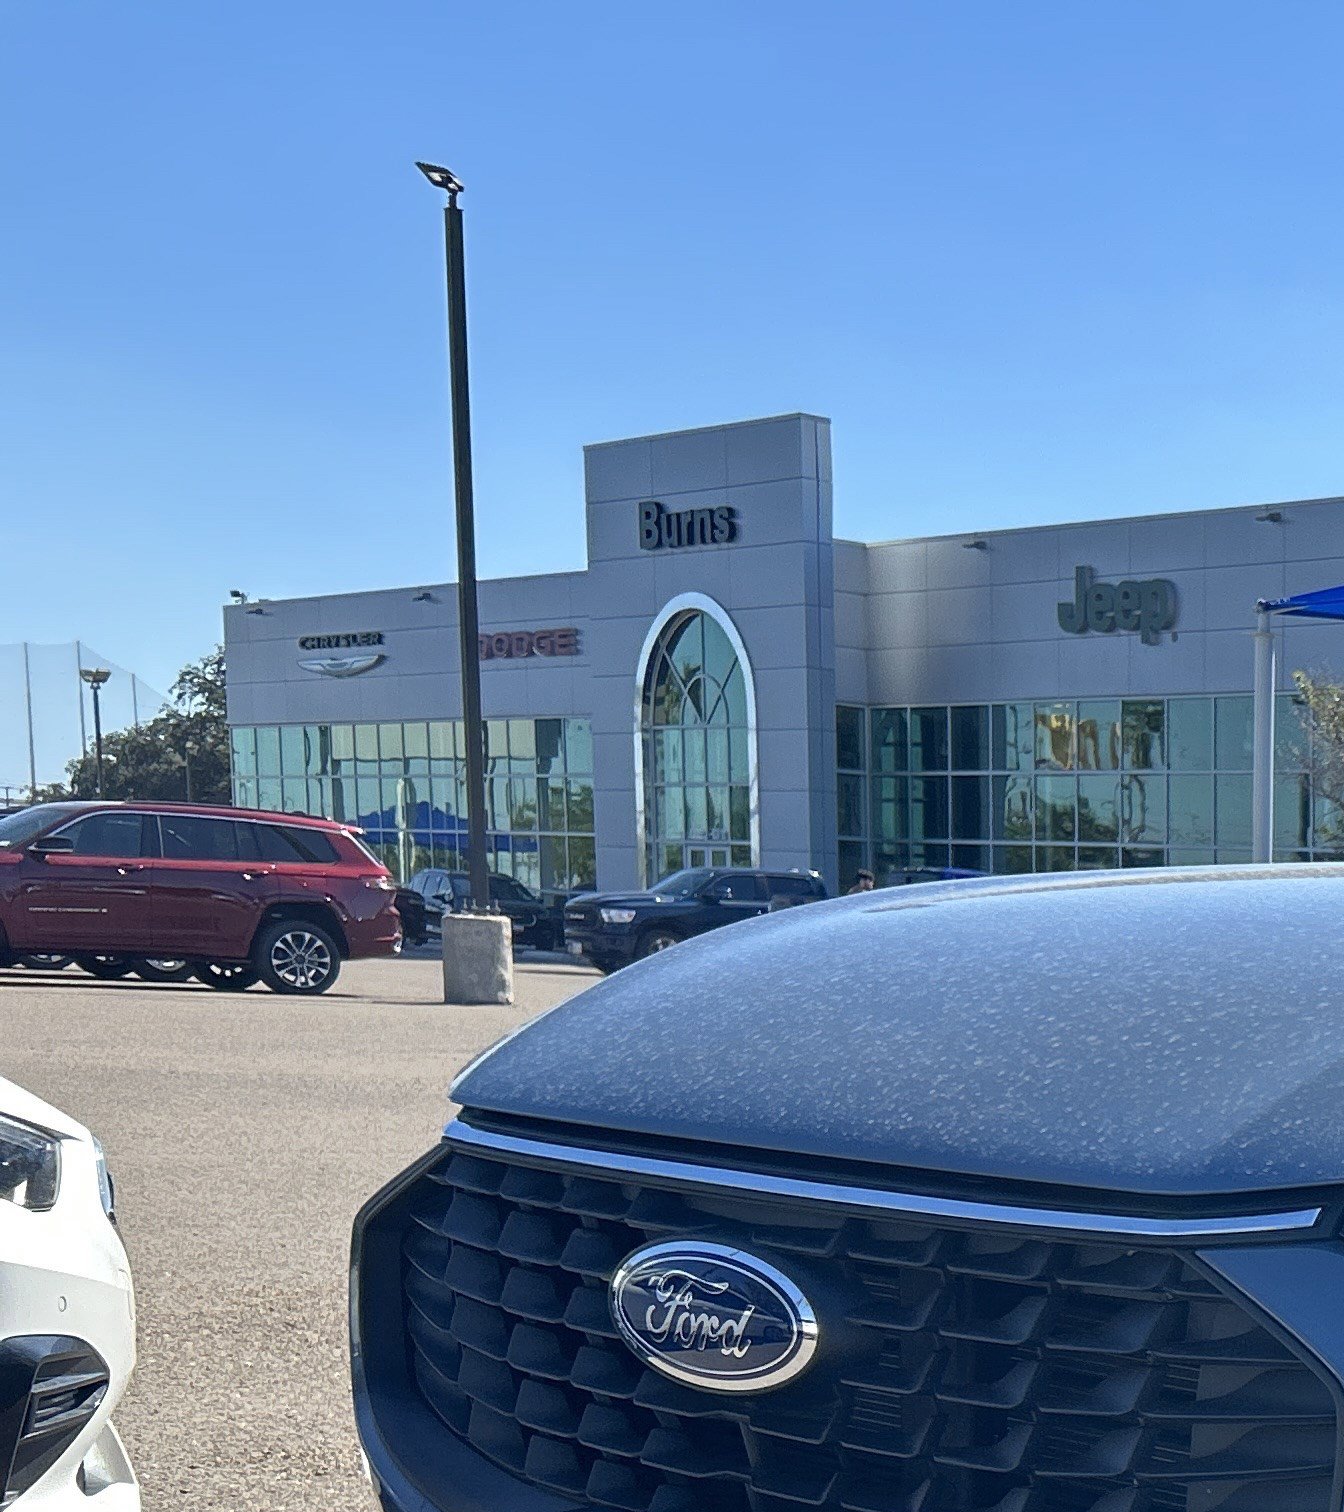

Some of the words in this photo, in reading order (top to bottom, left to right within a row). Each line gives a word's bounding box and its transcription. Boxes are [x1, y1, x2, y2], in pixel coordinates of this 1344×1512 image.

[639, 500, 737, 550] Burns
[1057, 565, 1178, 646] Jeep
[299, 631, 384, 650] CHRYSLER
[645, 1268, 755, 1359] Ford
